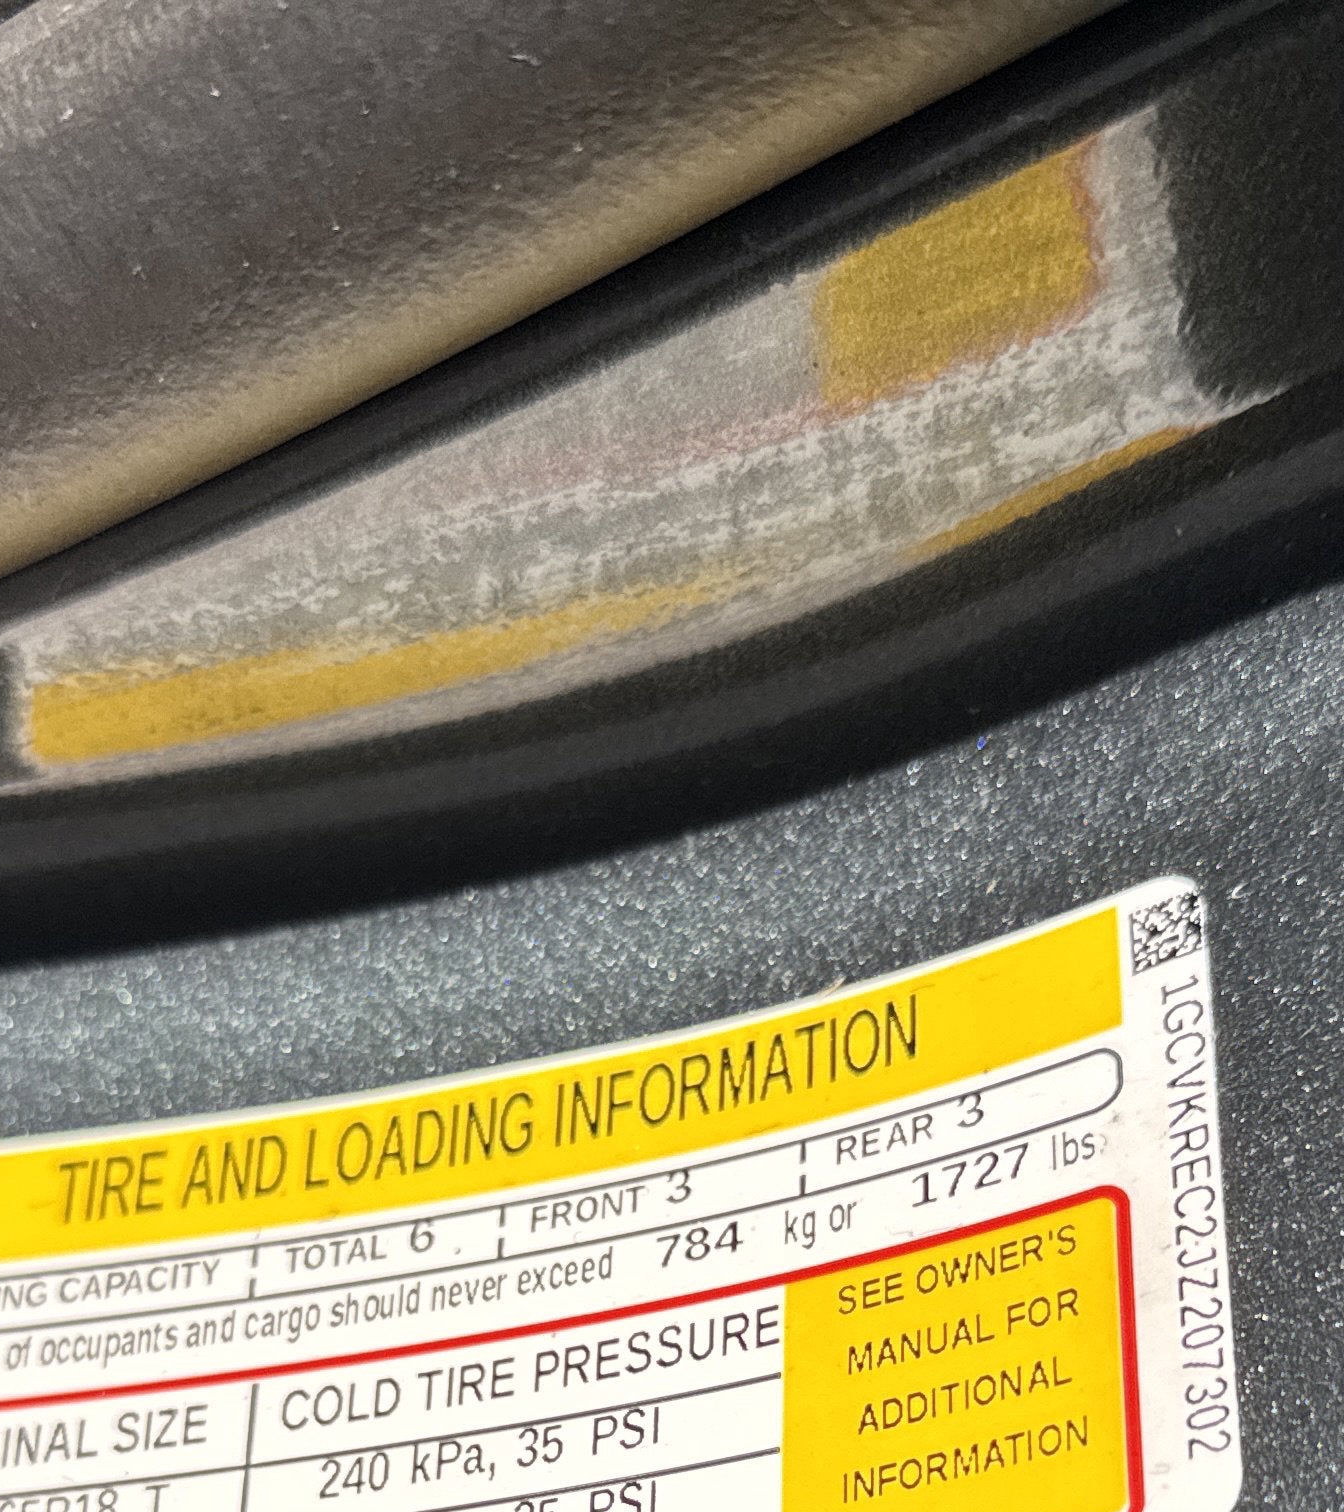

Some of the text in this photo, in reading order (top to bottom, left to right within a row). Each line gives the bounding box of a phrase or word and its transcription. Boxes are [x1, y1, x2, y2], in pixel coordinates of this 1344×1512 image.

[59, 993, 918, 1225] TIRE AND LOADING INFORMATION
[59, 1258, 220, 1305] CAPACITY
[286, 1235, 387, 1275] TOTAL
[409, 1218, 435, 1253] 6
[530, 1185, 646, 1233] FRONT
[665, 1169, 693, 1204] 3
[835, 1113, 933, 1165] REAR
[956, 1093, 985, 1128] 3
[6, 1335, 33, 1370] of
[40, 1325, 178, 1369] occupants
[186, 1310, 238, 1348] and
[244, 1302, 321, 1345] cargo
[330, 1281, 420, 1327] should
[431, 1271, 510, 1312] never
[517, 1246, 613, 1295] exceed
[657, 1221, 744, 1269] 784
[784, 1208, 816, 1249] kg
[829, 1200, 857, 1231] or
[911, 1142, 1029, 1208] 1727
[838, 1226, 1077, 1316] SEE OWNER'S
[114, 1405, 208, 1452] SIZE
[281, 1377, 400, 1431] COLD
[417, 1358, 516, 1410] TIRE
[534, 1303, 781, 1389] PRESSURE
[848, 1289, 1079, 1376] MANUAL FOR
[856, 1356, 1072, 1436] ADDITIONAL
[320, 1452, 389, 1500] 240
[412, 1437, 496, 1485] kPa,
[518, 1425, 564, 1468] 35
[591, 1406, 659, 1456] PSI
[841, 1416, 1089, 1504] INFORMATION
